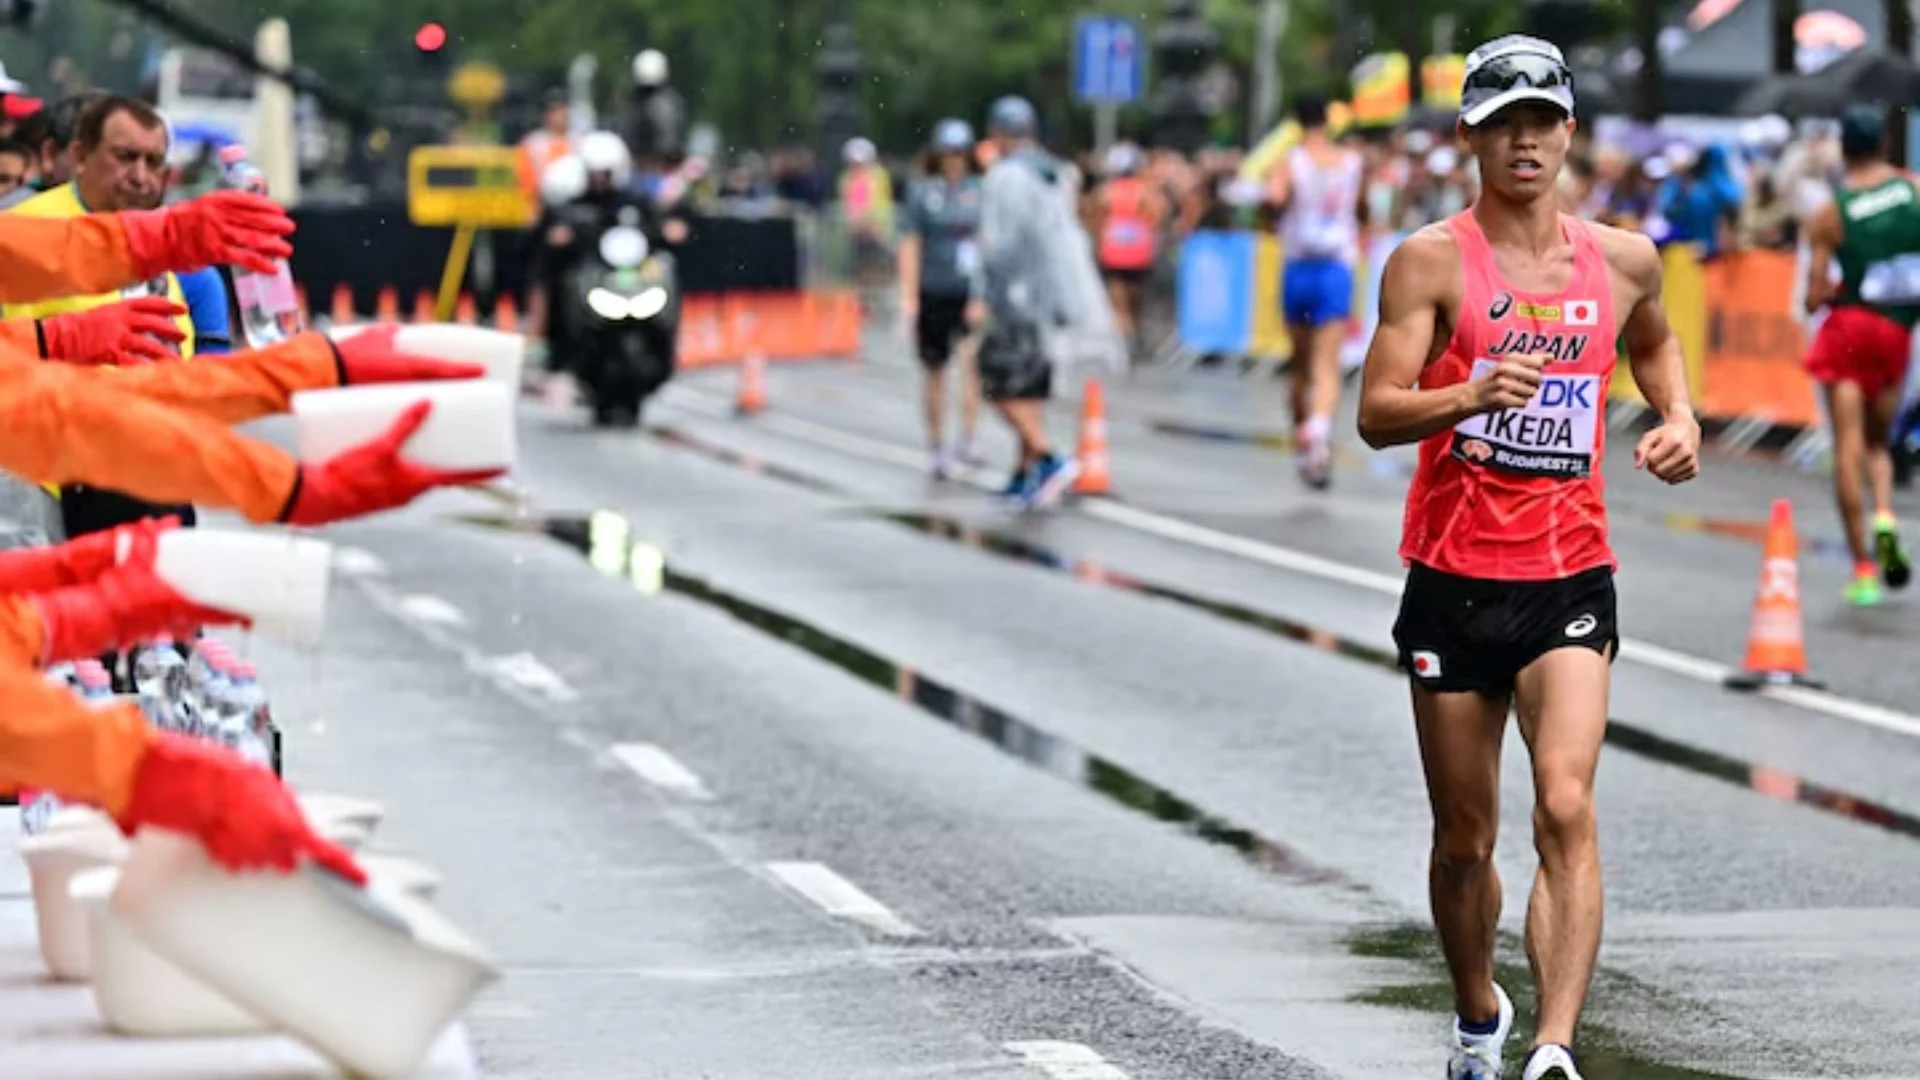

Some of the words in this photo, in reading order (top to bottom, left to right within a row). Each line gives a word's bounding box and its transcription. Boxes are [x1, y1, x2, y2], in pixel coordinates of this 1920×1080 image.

[1489, 329, 1588, 361] JAPAN
[1539, 379, 1590, 408] DK
[1484, 409, 1573, 448] IKEDA
